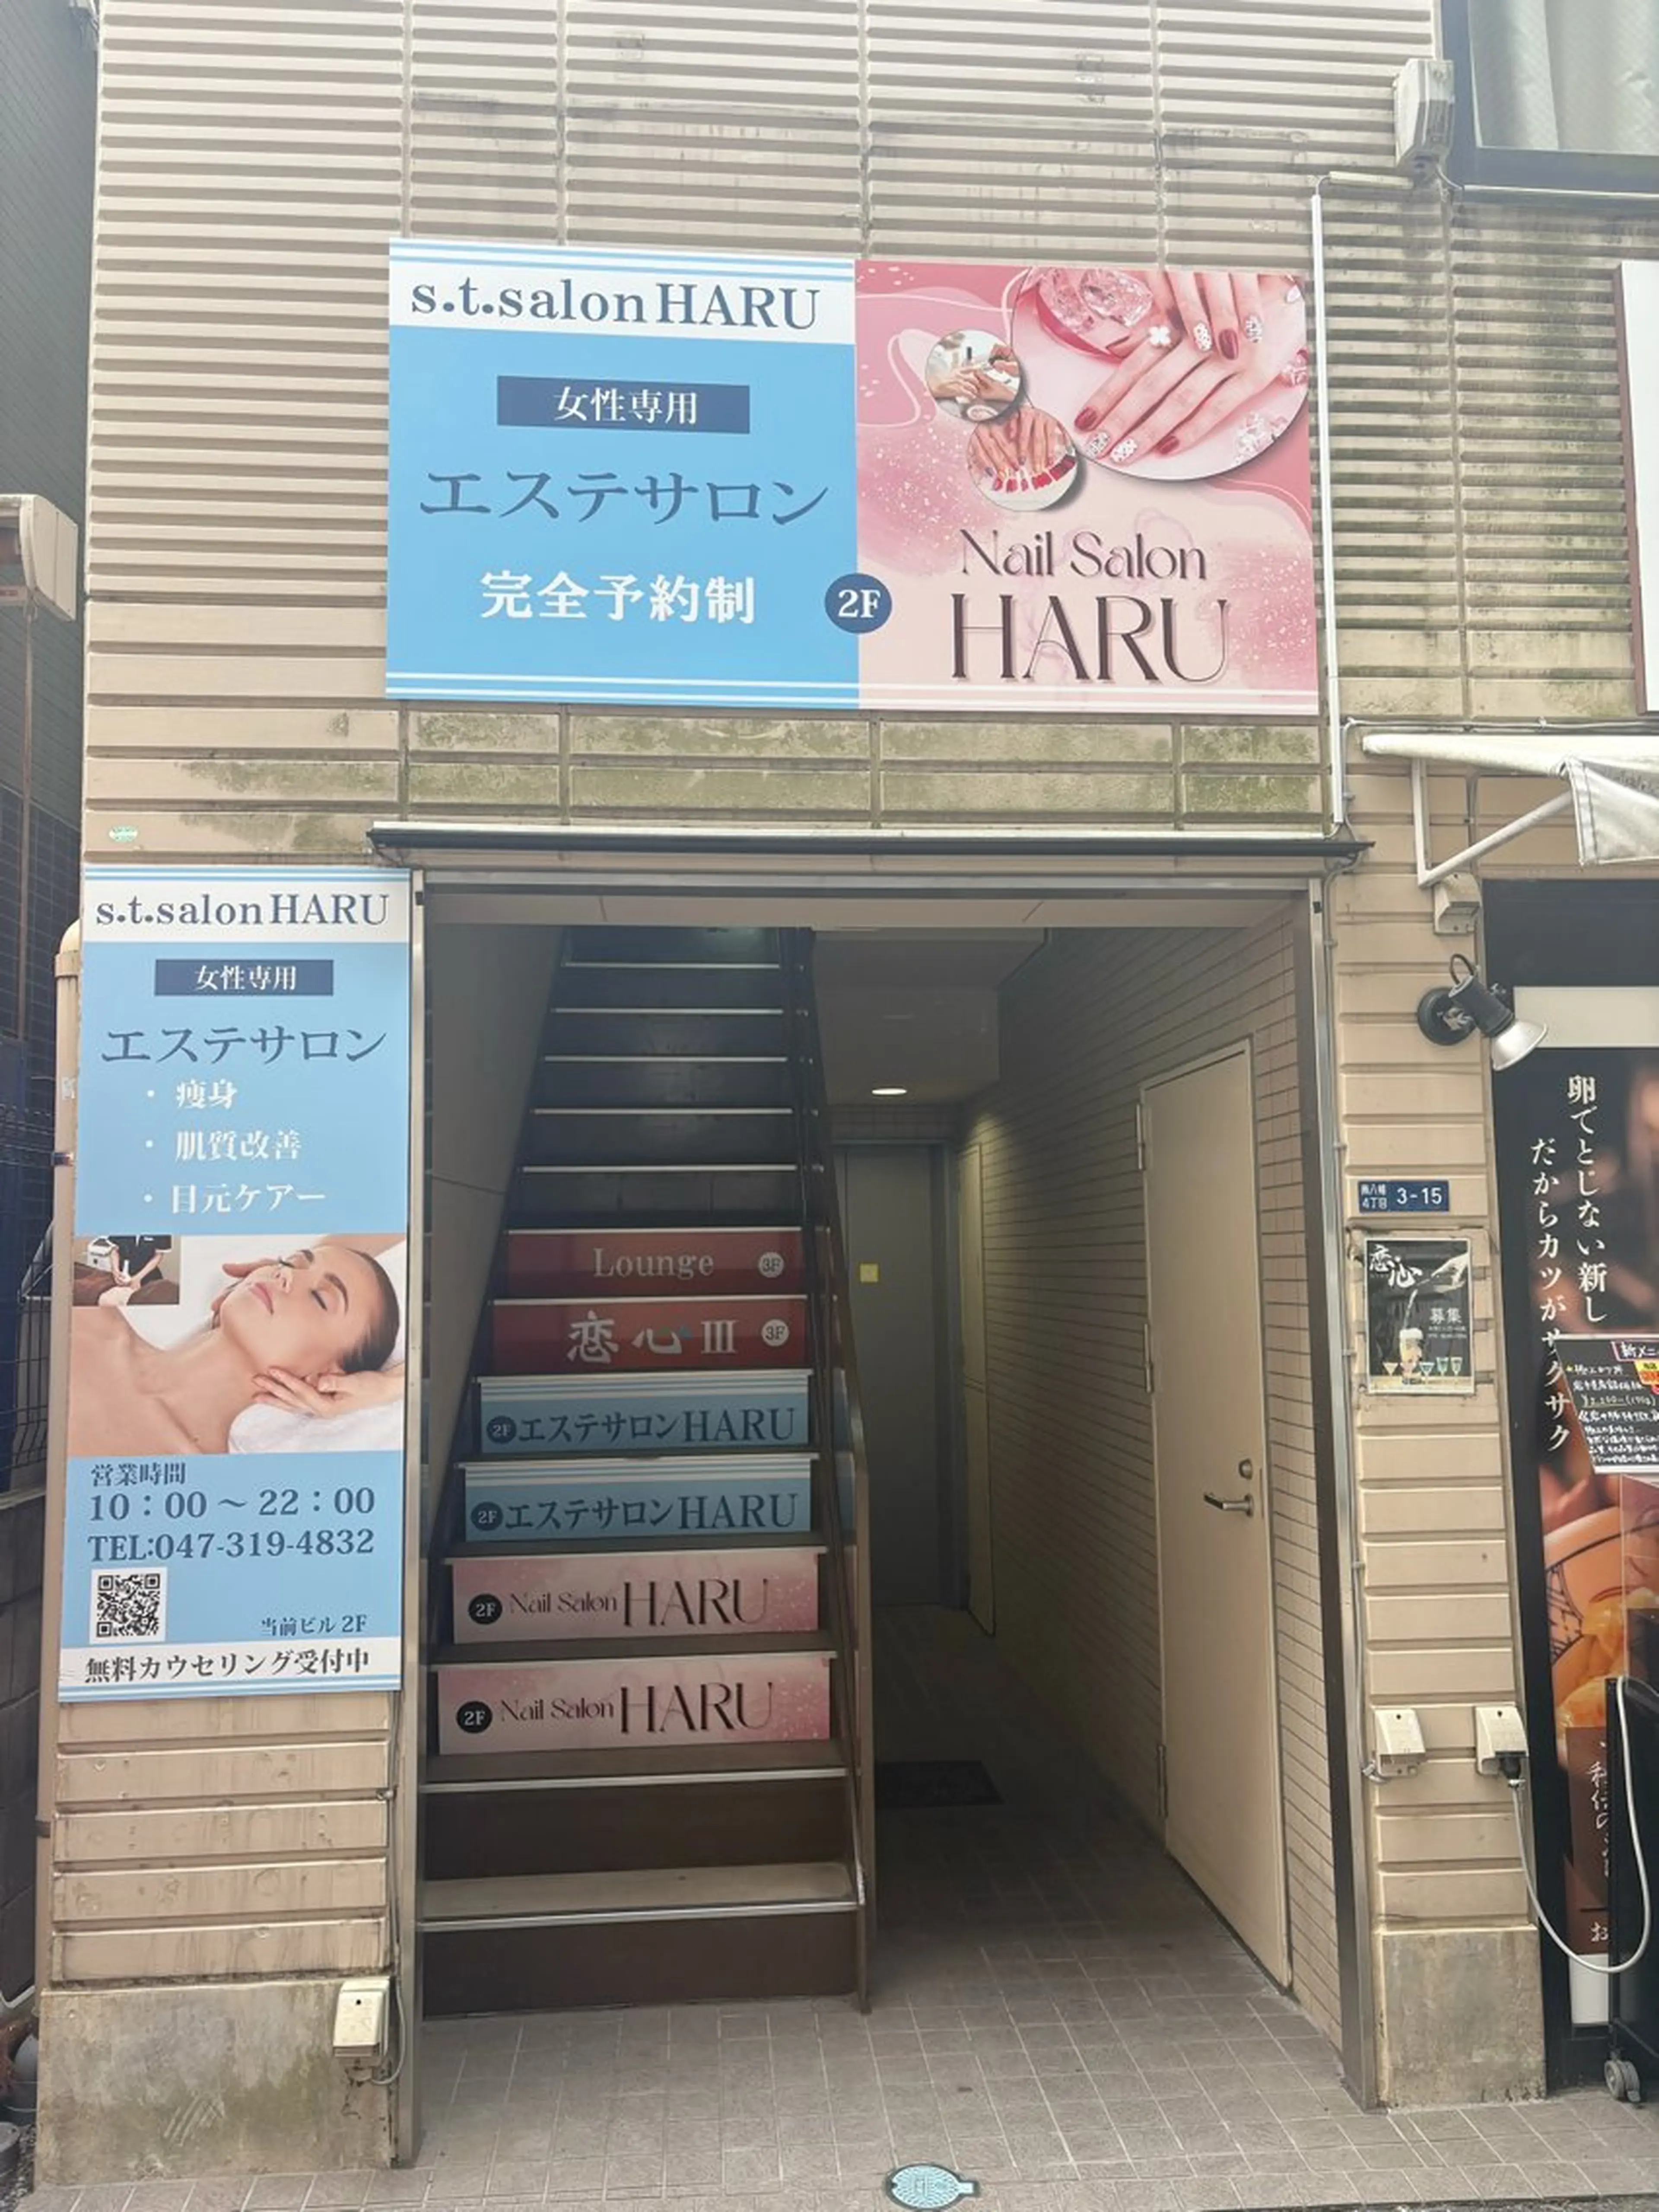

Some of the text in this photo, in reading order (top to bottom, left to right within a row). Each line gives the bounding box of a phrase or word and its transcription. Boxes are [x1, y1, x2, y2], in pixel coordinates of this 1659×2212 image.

[554, 387, 697, 424] 女性専用
[420, 472, 828, 525] エステサロン
[960, 529, 1207, 580] Nail Salon
[480, 570, 755, 623] 完全予約制
[838, 589, 880, 618] 2F
[951, 593, 1227, 682] HARU
[195, 966, 296, 991] 女性専用
[102, 1026, 387, 1064] エステサロン
[175, 1130, 302, 1161] 肌質改善
[173, 1184, 325, 1214] 目元ケアー
[1396, 1187, 1442, 1205] 3-15
[593, 1248, 714, 1280] Lounge
[762, 1258, 781, 1272] 3F
[1430, 1308, 1462, 1324] 募集
[765, 1326, 785, 1340] 3F
[1621, 1341, 1659, 1358] 新メニ
[91, 1463, 186, 1487] 営業時間
[478, 1510, 497, 1524] 2F
[89, 1528, 374, 1562] TEL:047-319-4832
[476, 1602, 496, 1617] 2F
[510, 1578, 769, 1627] Nail Salon HARU
[342, 1615, 366, 1632] 2F
[85, 1648, 369, 1684] 無料カウセリング受付中
[464, 1711, 486, 1726] 2F
[500, 1682, 772, 1734] Nail Salon HARU
